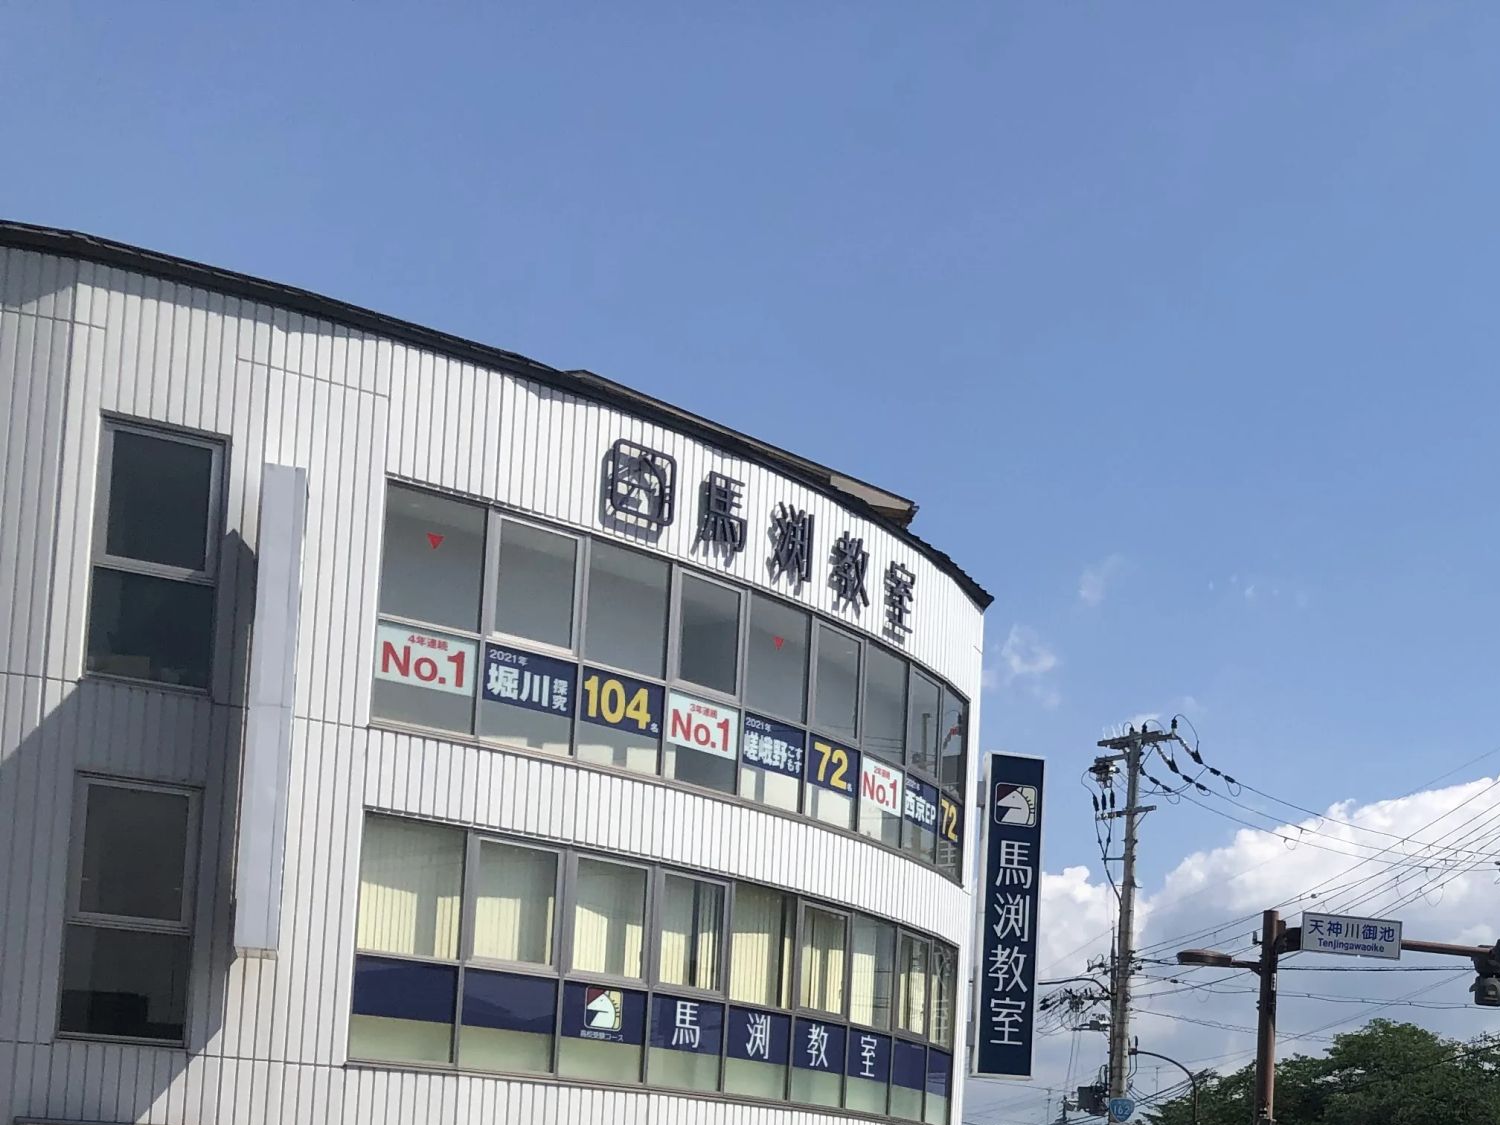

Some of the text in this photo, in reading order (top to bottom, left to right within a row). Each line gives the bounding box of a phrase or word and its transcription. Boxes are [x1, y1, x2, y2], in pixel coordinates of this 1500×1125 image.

[700, 470, 916, 635] 馬渕教室
[381, 640, 465, 688] No.1
[407, 634, 449, 651] 4年連続
[488, 648, 528, 667] 2021年
[487, 662, 569, 711] 堀川 探究
[584, 674, 651, 730] 104
[671, 708, 730, 752] No.1
[745, 716, 772, 733] 2021年
[814, 741, 849, 790] 72
[863, 770, 897, 809] No.1
[905, 789, 936, 826] 西京EP
[941, 798, 958, 842] 72
[988, 839, 1033, 1046] 馬渕教室
[1308, 919, 1395, 943] 天神川御池
[1317, 937, 1385, 953] Tenjingawaoike
[672, 1000, 878, 1078] 馬渕教室
[1113, 1105, 1130, 1115] 162
